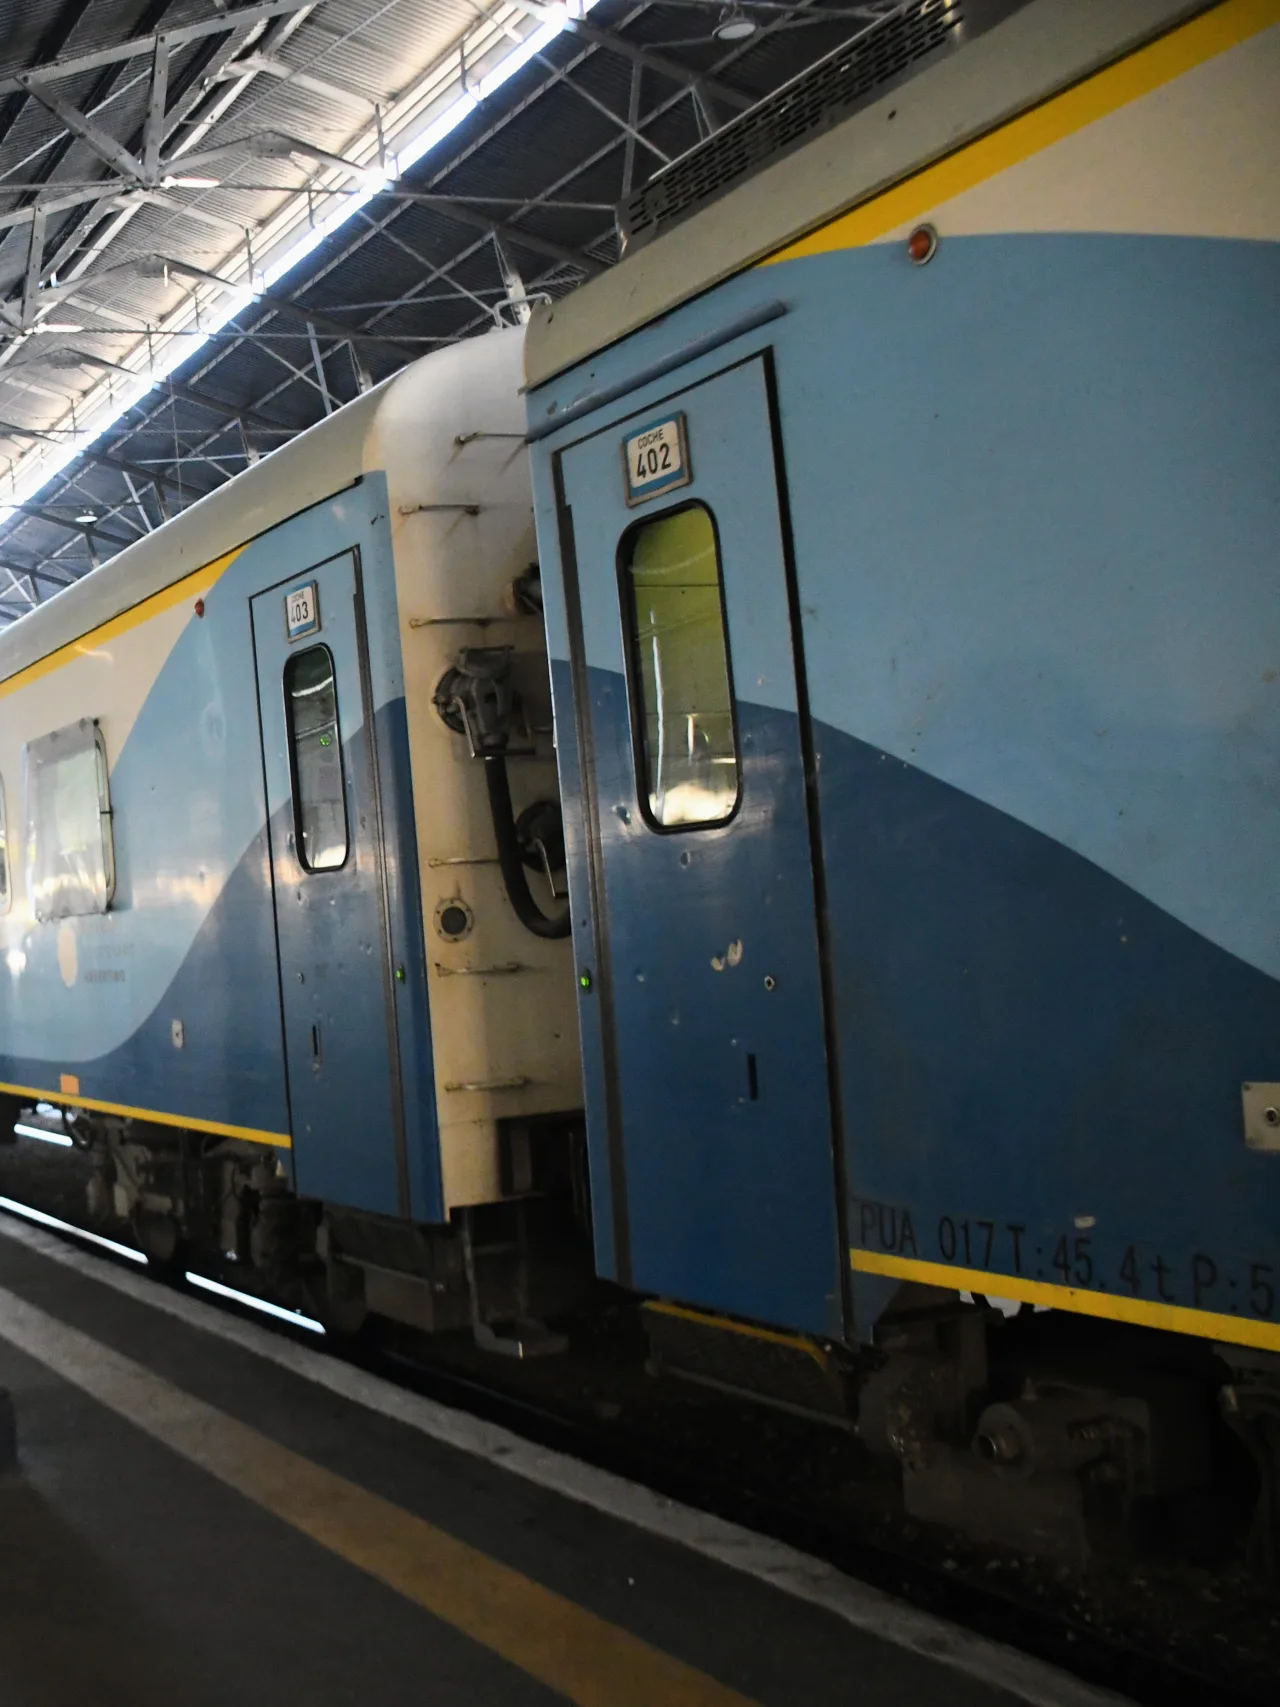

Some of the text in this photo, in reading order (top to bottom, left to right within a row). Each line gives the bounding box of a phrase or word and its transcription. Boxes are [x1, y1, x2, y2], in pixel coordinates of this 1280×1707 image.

[637, 428, 664, 450] COCHE
[636, 443, 671, 478] 402
[291, 601, 309, 623] 403
[859, 1201, 917, 1257] PUA
